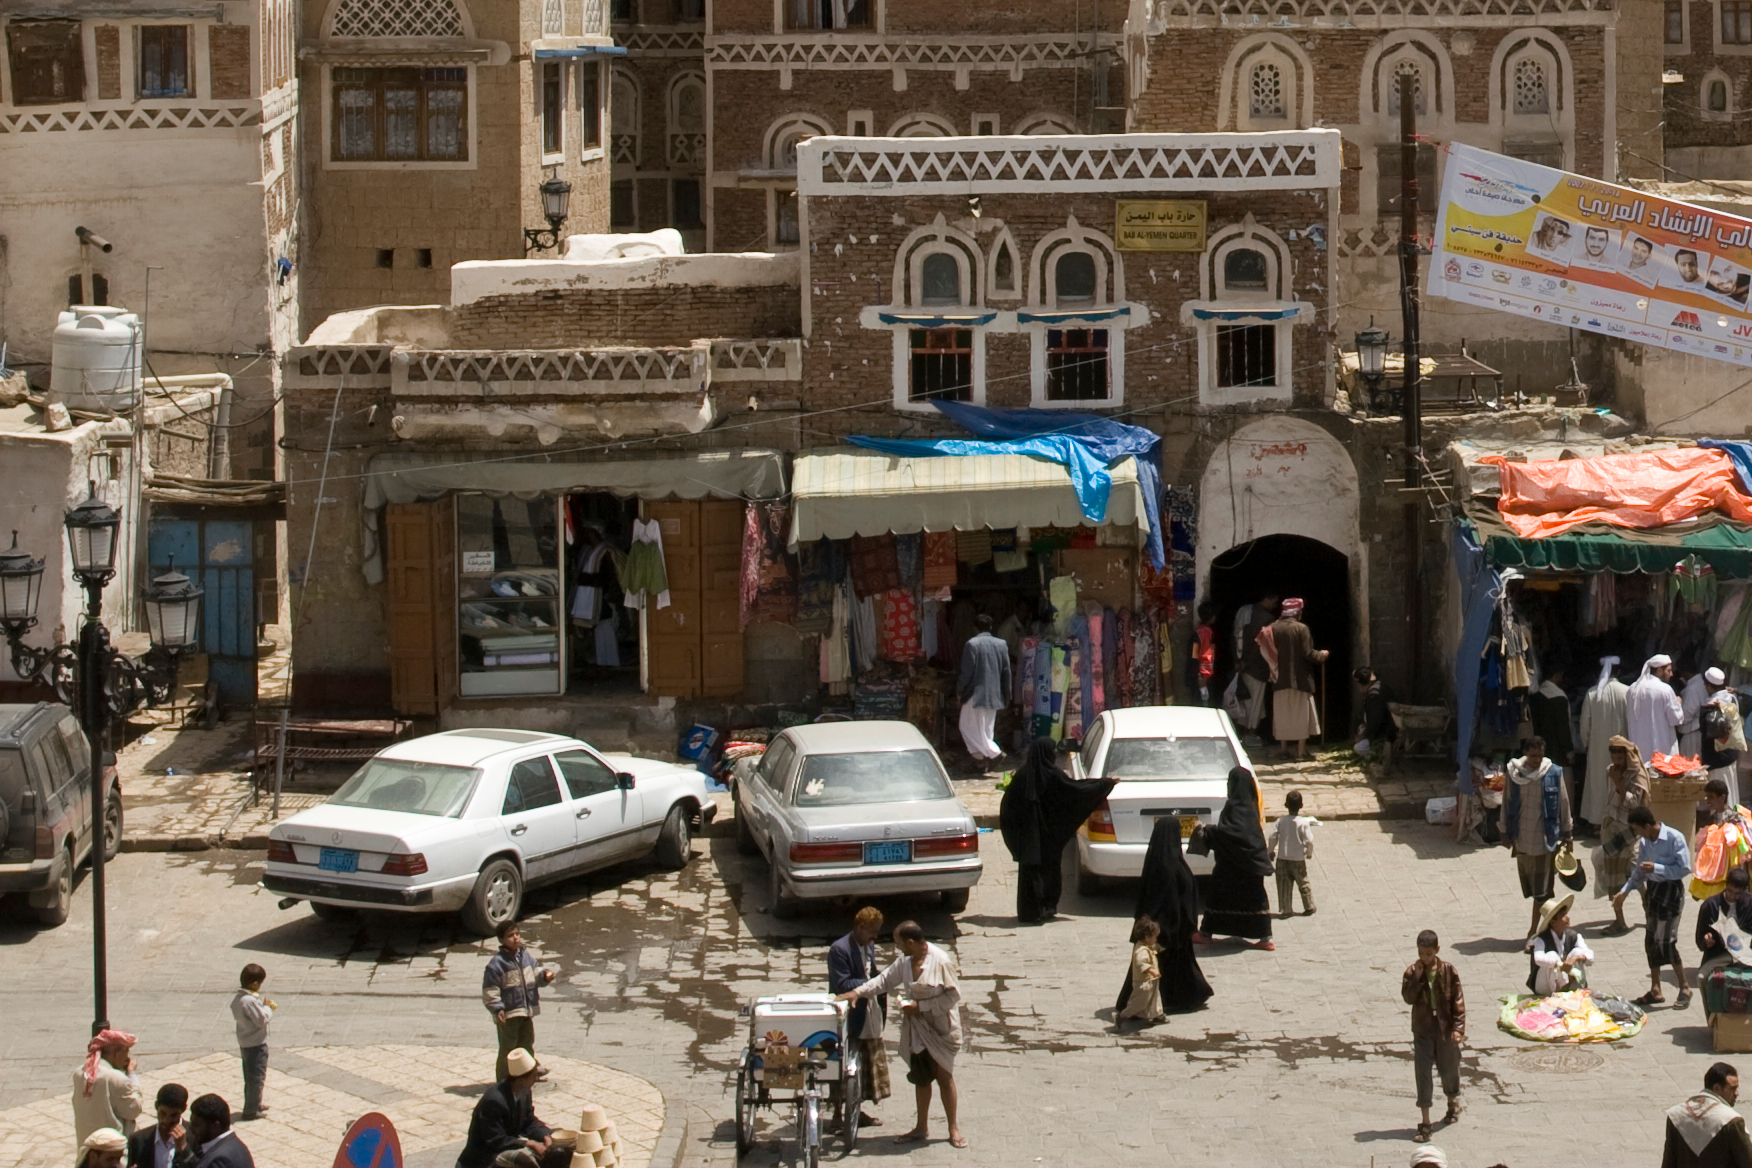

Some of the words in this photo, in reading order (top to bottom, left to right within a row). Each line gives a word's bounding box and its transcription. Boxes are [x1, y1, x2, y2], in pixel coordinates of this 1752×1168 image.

[1578, 194, 1646, 225] العربي
[1125, 211, 1155, 223] اليمن
[1157, 211, 1174, 223] باب
[1176, 209, 1196, 223] حارة
[1648, 205, 1713, 241] الإنشاد
[1123, 230, 1136, 240] BAB
[1136, 230, 1168, 240] AL-YEMEN
[1169, 230, 1198, 240] QUARTER
[1496, 233, 1524, 245] حديقة
